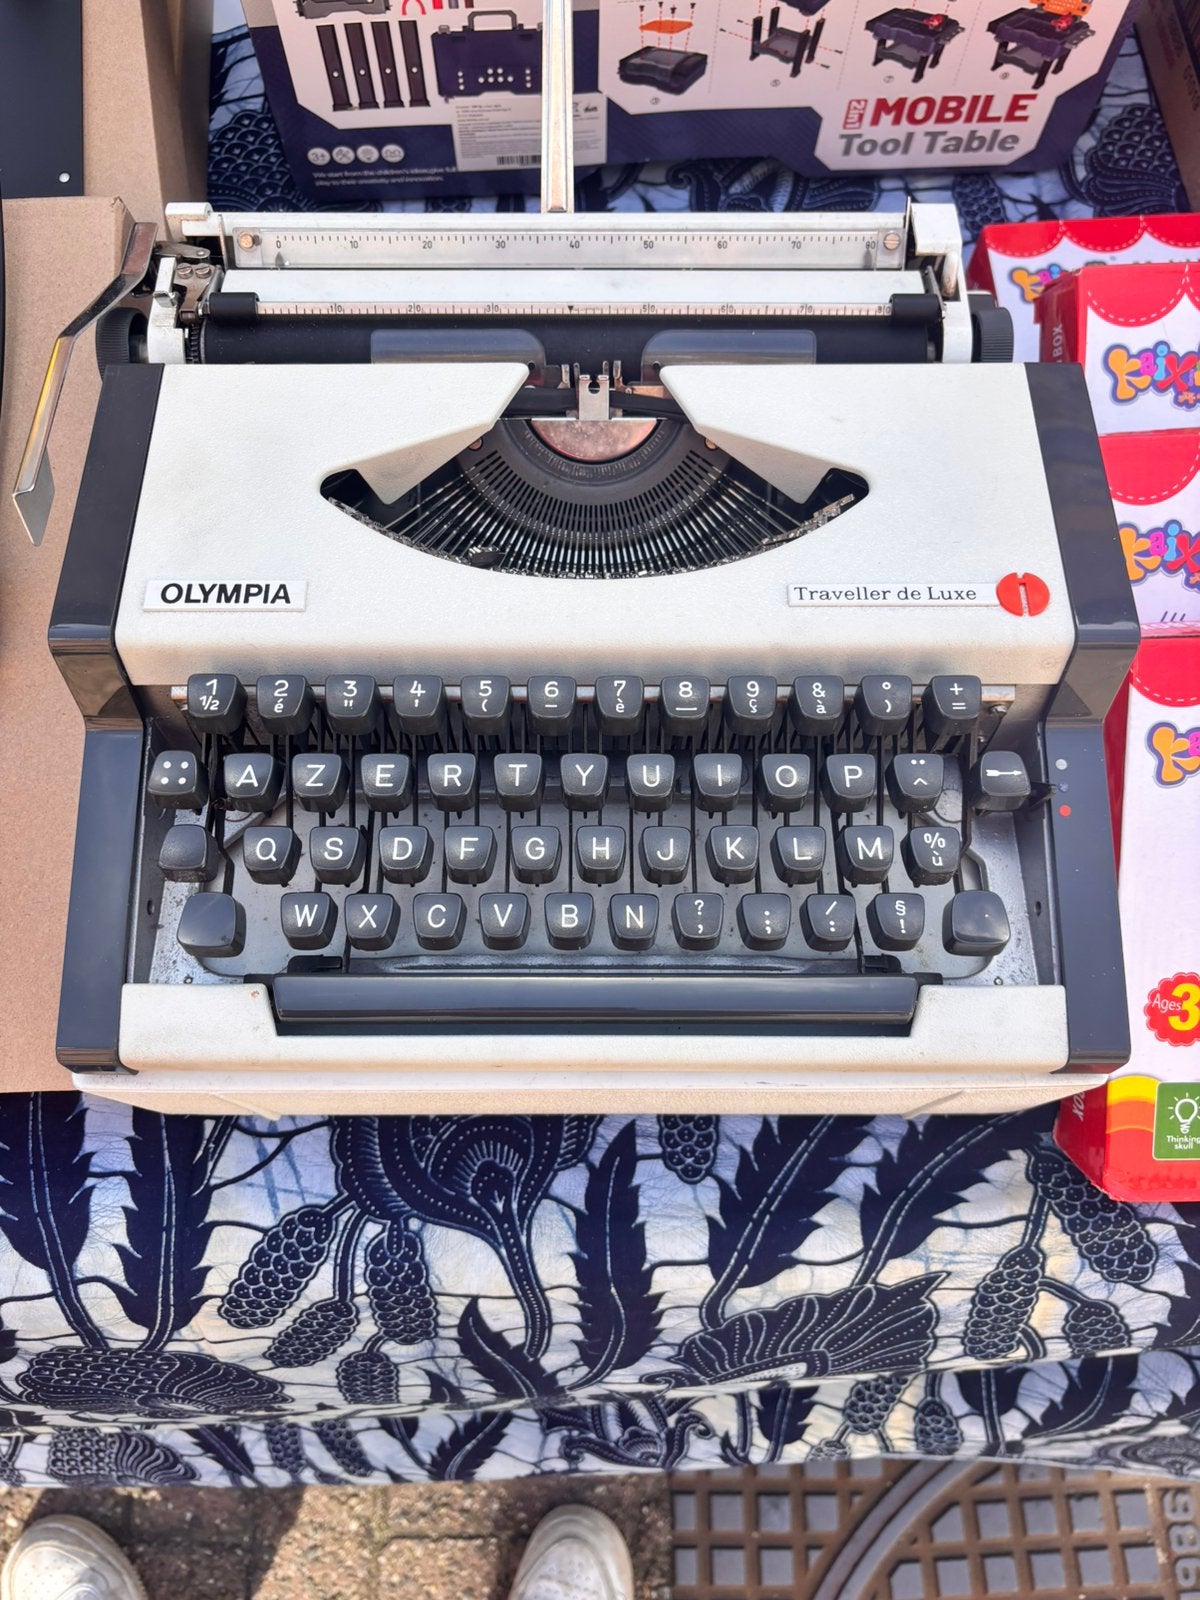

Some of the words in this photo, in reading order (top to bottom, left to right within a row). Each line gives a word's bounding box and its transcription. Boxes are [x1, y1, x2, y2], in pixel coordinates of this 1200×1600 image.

[870, 94, 1038, 127] MOBILE
[839, 131, 914, 157] Tool
[924, 129, 1019, 155] Table
[350, 240, 359, 250] 10
[422, 240, 433, 250] 20
[495, 240, 506, 250] 30
[569, 240, 580, 250] 40
[644, 240, 654, 250] 50
[717, 240, 728, 250] 60
[791, 240, 802, 250] 70
[865, 240, 876, 250] 80
[1052, 323, 1063, 357] BOX
[160, 583, 291, 604] OLYMPIA
[794, 586, 892, 600] Traveller
[896, 586, 922, 600] de
[927, 586, 977, 600] Luxe
[203, 679, 218, 696] 1
[273, 679, 289, 697] 2
[343, 680, 358, 697] 3
[408, 680, 427, 698] 4
[478, 680, 493, 697] 5
[544, 680, 559, 698] 6
[613, 680, 627, 697] 7
[678, 681, 693, 698] 8
[746, 680, 760, 698] 9
[812, 682, 826, 698] &
[274, 698, 284, 713] é
[615, 697, 625, 713] è
[748, 698, 758, 714] ç
[816, 699, 827, 714] à
[235, 764, 259, 788] A
[304, 764, 326, 787] Z
[374, 764, 395, 787] E
[443, 764, 462, 787] R
[508, 763, 528, 787] T
[575, 764, 596, 787] Y
[642, 764, 661, 788] U
[775, 764, 800, 788] O
[843, 765, 863, 788] P
[255, 837, 277, 862] Q
[323, 837, 344, 861] S
[391, 837, 413, 861] D
[457, 837, 479, 860] F
[524, 837, 546, 861] G
[592, 836, 610, 860] H
[656, 838, 674, 861] J
[725, 836, 745, 860] K
[792, 837, 815, 861] L
[856, 836, 884, 860] M
[923, 832, 946, 849] %
[931, 849, 944, 867] ù
[294, 904, 319, 928] W
[358, 904, 378, 929] X
[427, 904, 447, 929] C
[493, 903, 513, 928] V
[560, 904, 579, 928] B
[625, 904, 644, 929] N
[694, 899, 705, 916] ?
[1151, 993, 1182, 1014] Ages
[1168, 983, 1200, 1031] 3
